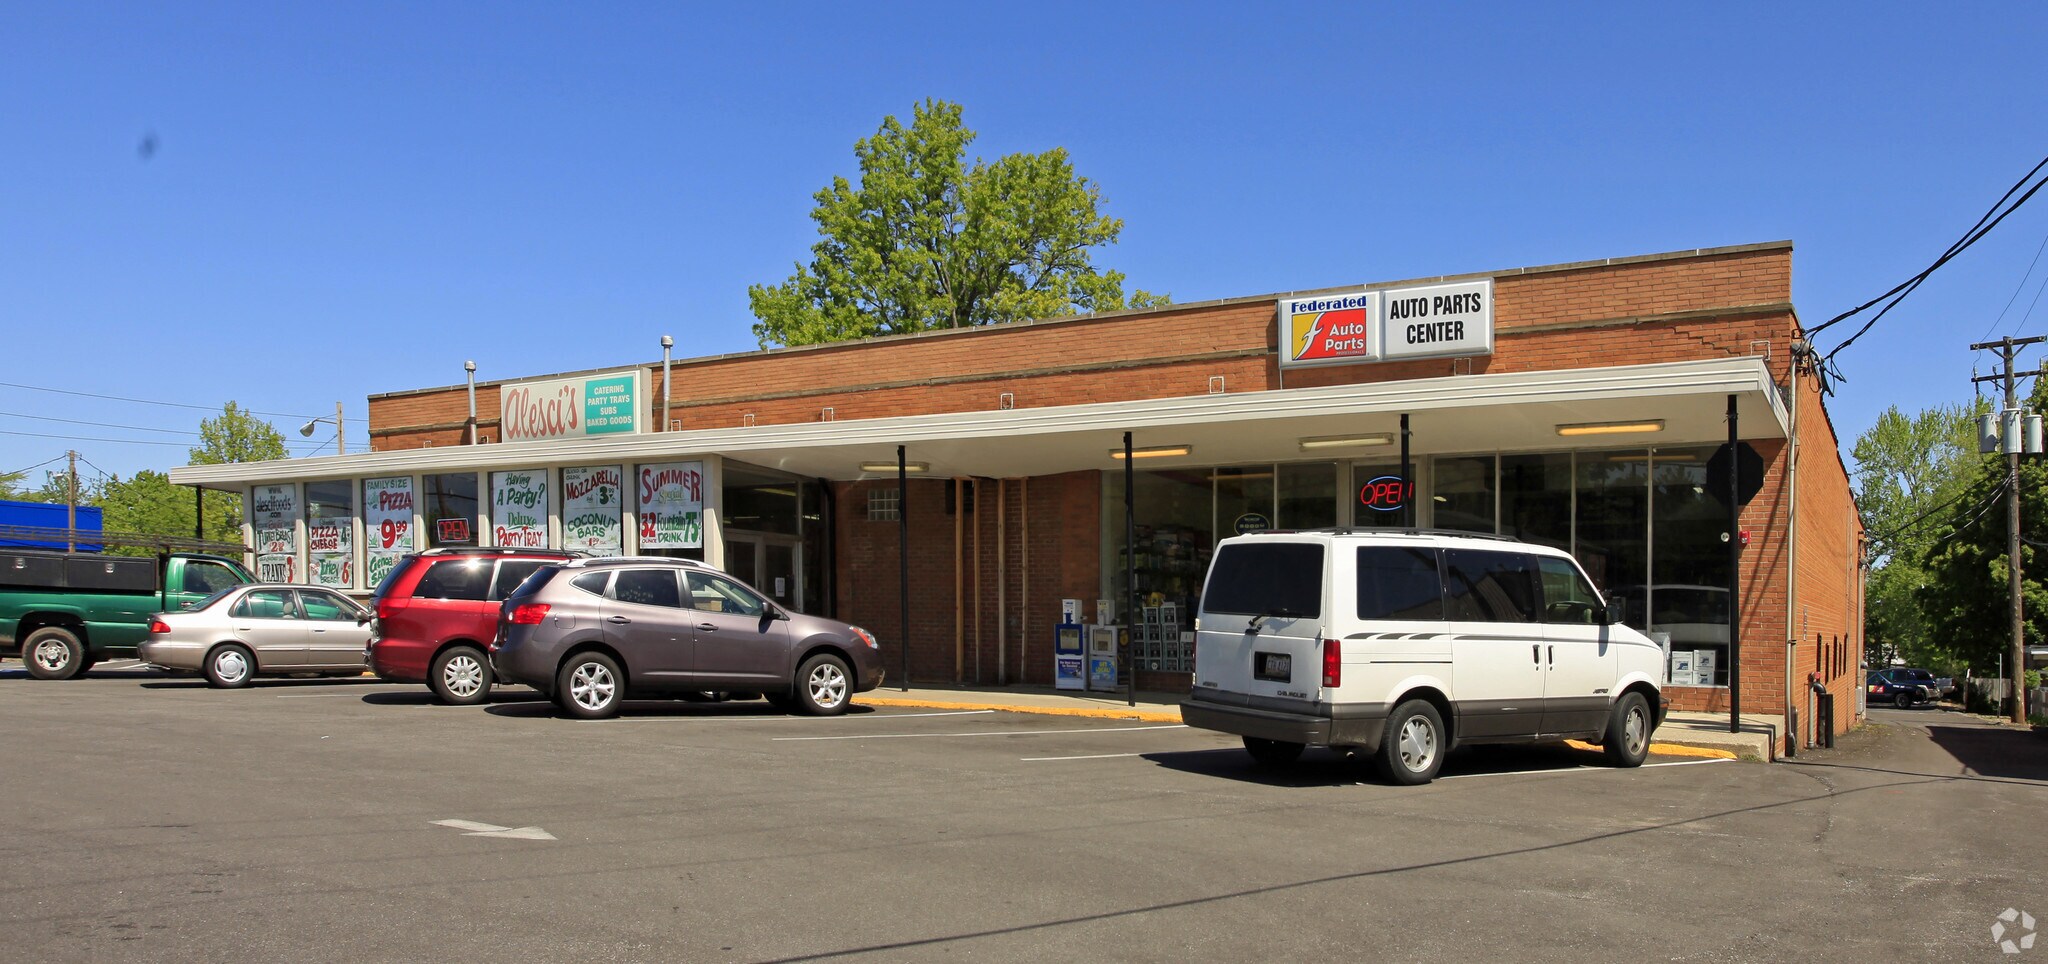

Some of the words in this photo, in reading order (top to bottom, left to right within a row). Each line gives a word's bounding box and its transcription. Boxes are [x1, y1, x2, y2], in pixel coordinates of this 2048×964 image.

[1291, 295, 1367, 313] Federated
[1389, 296, 1428, 320] AUTO
[1433, 292, 1481, 316] PARTS
[1329, 322, 1364, 336] Auto
[1406, 320, 1464, 345] CENTER
[1325, 337, 1364, 352] Parts
[594, 384, 625, 395] CATERING
[587, 396, 608, 406] PARTY
[610, 394, 630, 404] TRAYS
[505, 385, 578, 440] Alesci's
[600, 406, 617, 415] SUBS
[587, 417, 608, 427] BAKED
[609, 415, 632, 425] GOODS
[367, 480, 389, 490] FAMILY
[390, 479, 407, 488] SIZE
[505, 473, 531, 489] Having
[566, 470, 619, 500] MOZZARELLA
[641, 468, 701, 505] SUMMER
[380, 491, 413, 512] PIZZA
[496, 489, 504, 506] A
[506, 483, 546, 509] Party?
[438, 520, 469, 540] OPEN
[507, 512, 538, 530] Deluxe
[567, 513, 618, 533] COCONUT
[641, 512, 657, 538] 32
[657, 510, 686, 532] Fountain
[311, 526, 339, 538] PIZZA
[496, 526, 523, 548] PARTY
[521, 525, 543, 548] TRAY
[577, 526, 606, 539] BARS
[658, 532, 683, 543] DRINK
[310, 538, 339, 551] CHEESE
